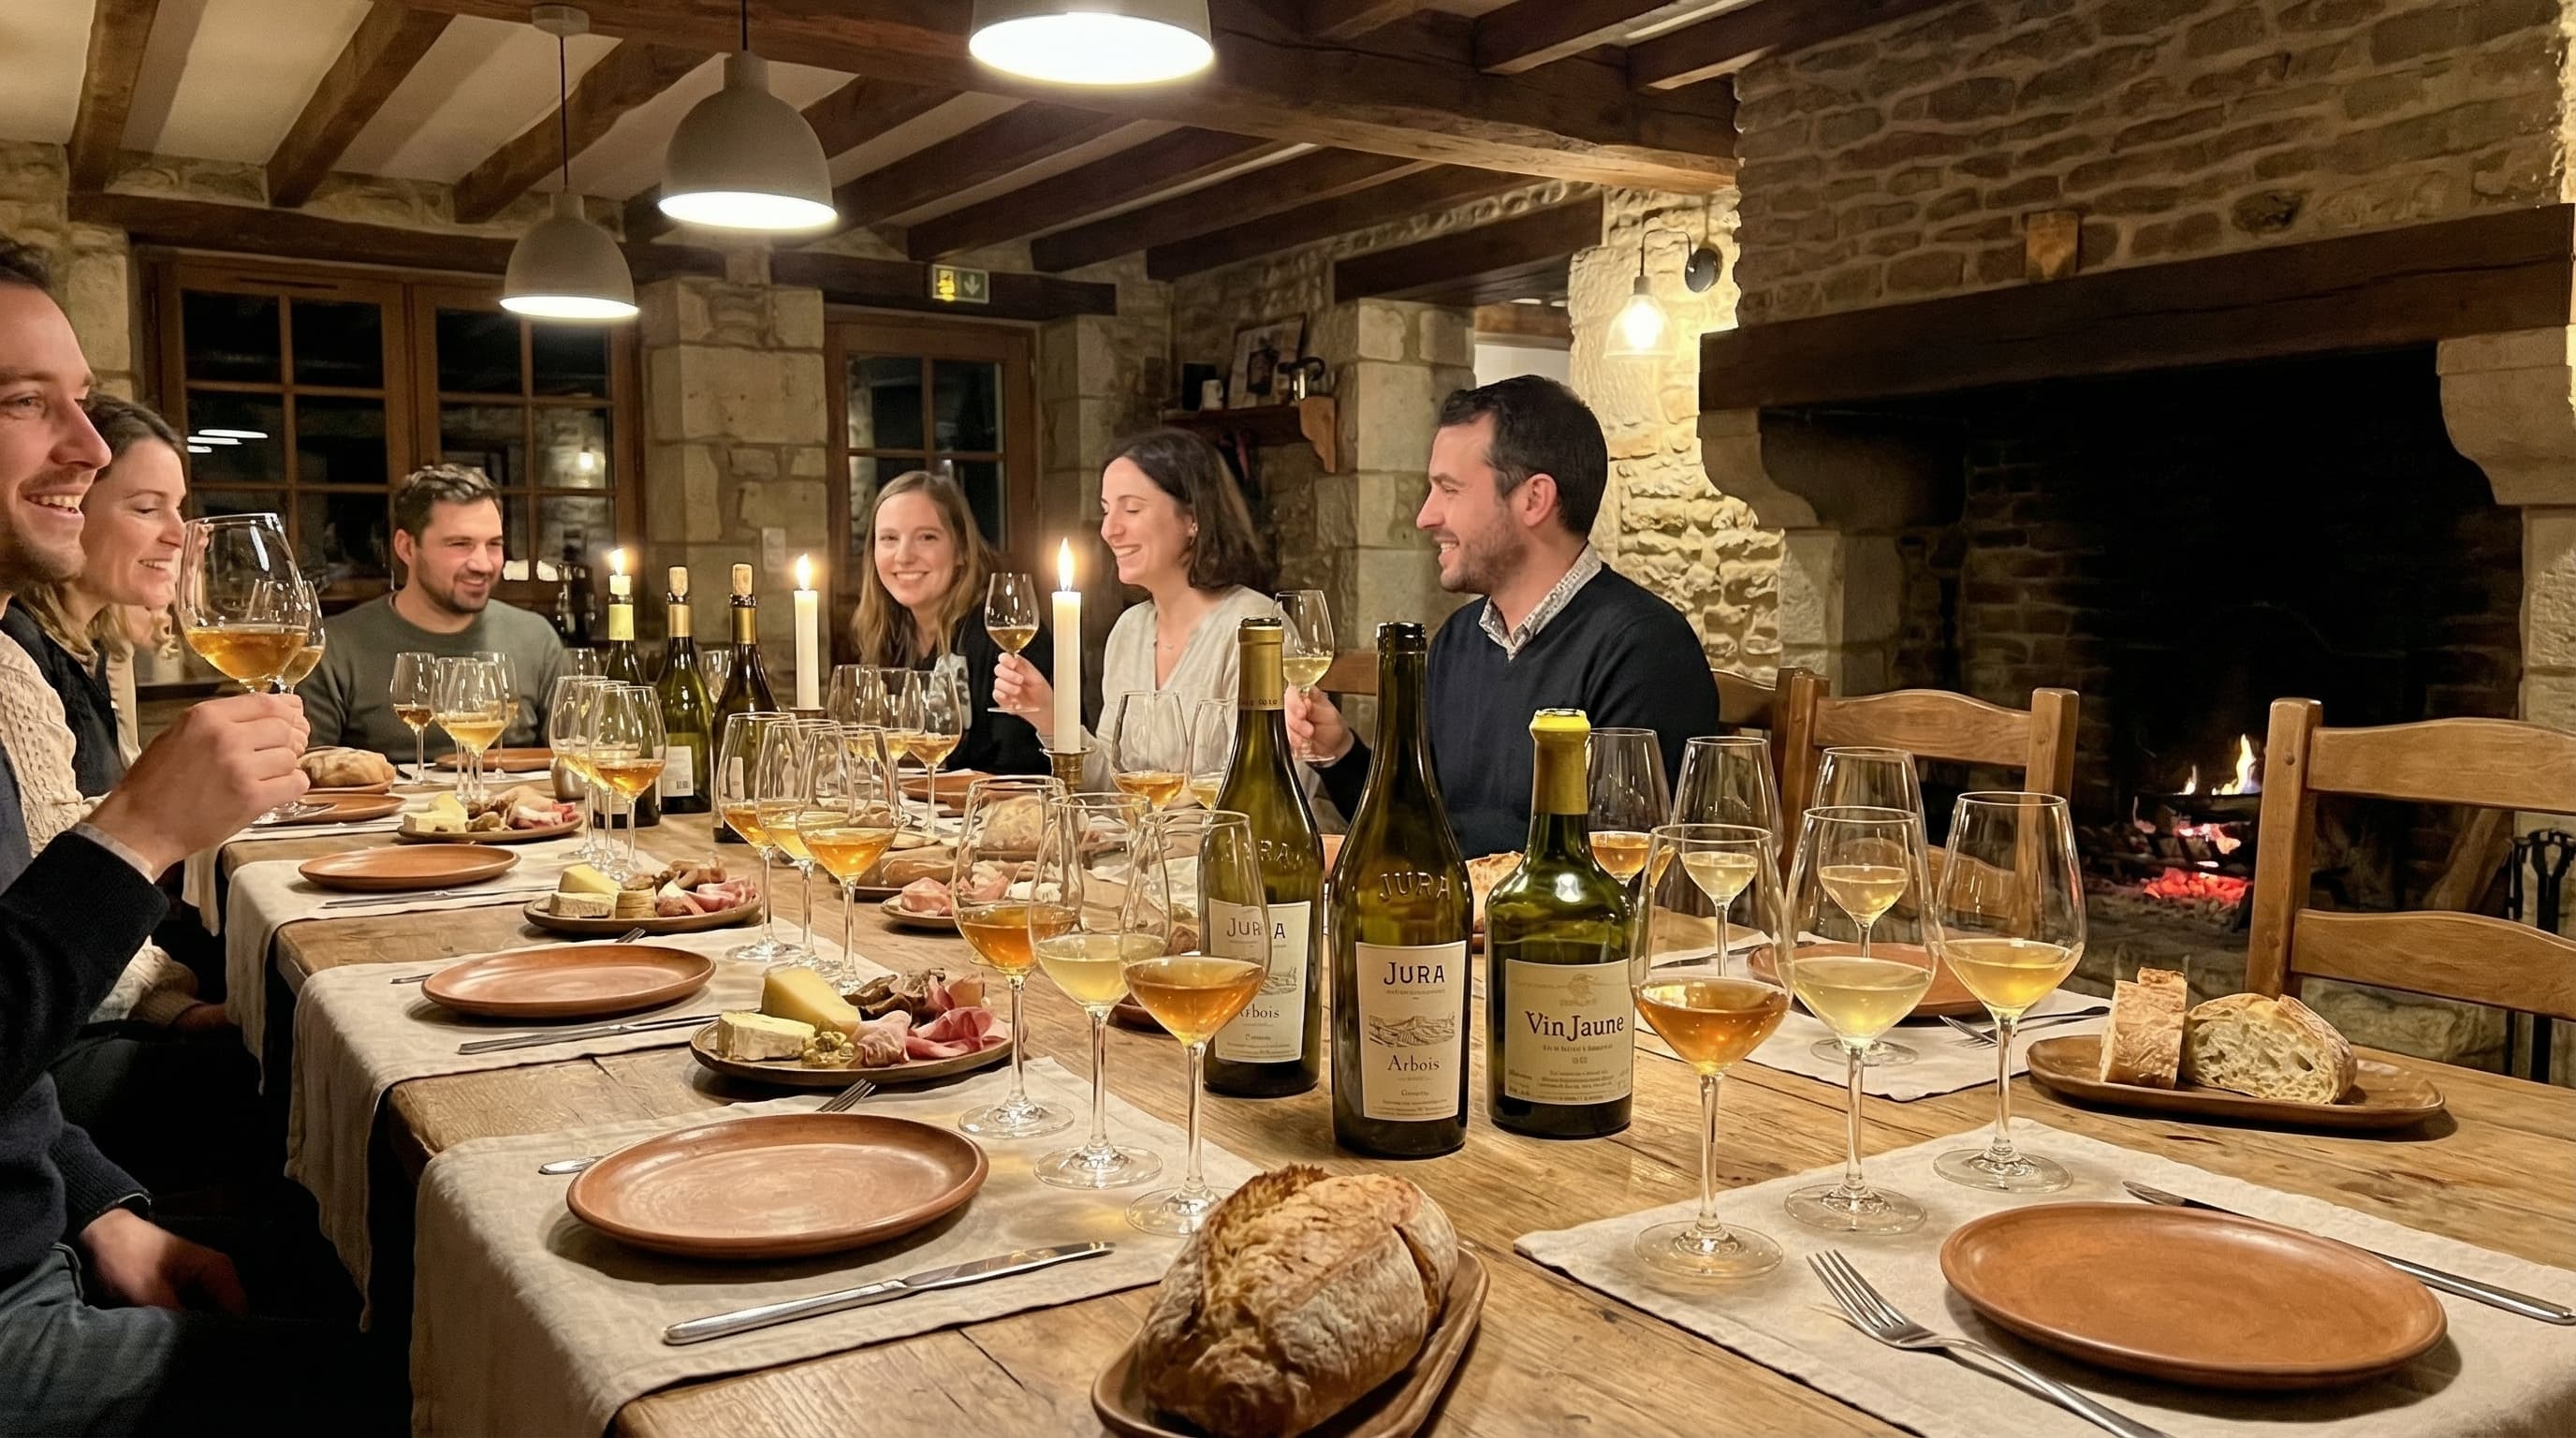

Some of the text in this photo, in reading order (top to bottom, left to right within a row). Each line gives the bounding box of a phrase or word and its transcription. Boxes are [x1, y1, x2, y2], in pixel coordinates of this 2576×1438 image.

[1379, 871, 1451, 902] JURA
[1226, 917, 1286, 940] JURA
[1383, 961, 1445, 985] JURA
[1524, 1010, 1624, 1042] Vin Jaune
[1387, 1054, 1440, 1072] Arbois
